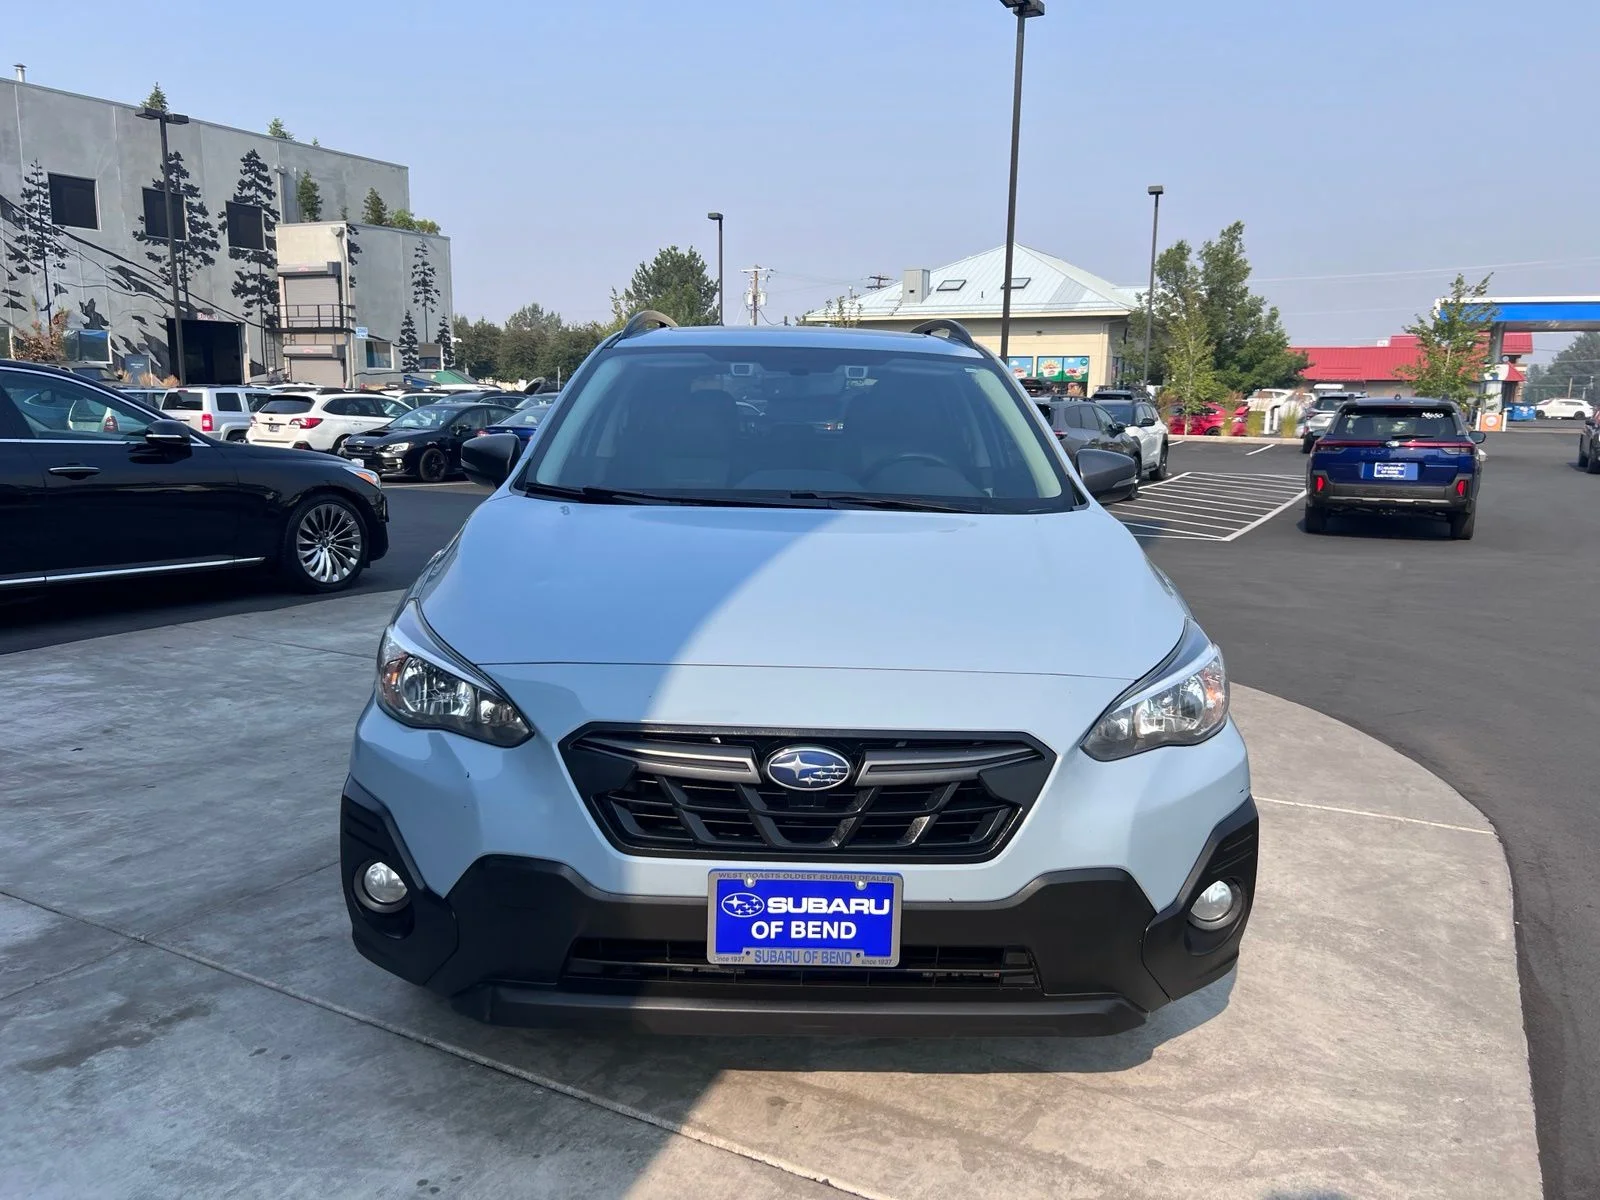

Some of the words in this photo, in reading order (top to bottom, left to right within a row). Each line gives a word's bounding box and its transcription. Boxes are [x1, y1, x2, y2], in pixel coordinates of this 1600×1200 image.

[819, 873, 857, 881] SUBARU
[858, 874, 894, 882] DEALER
[767, 897, 890, 915] SUBARU
[751, 921, 784, 939] OF
[790, 921, 857, 939] BEND
[754, 949, 800, 964] SUBARU
[803, 950, 819, 964] OF
[821, 951, 852, 965] BEND
